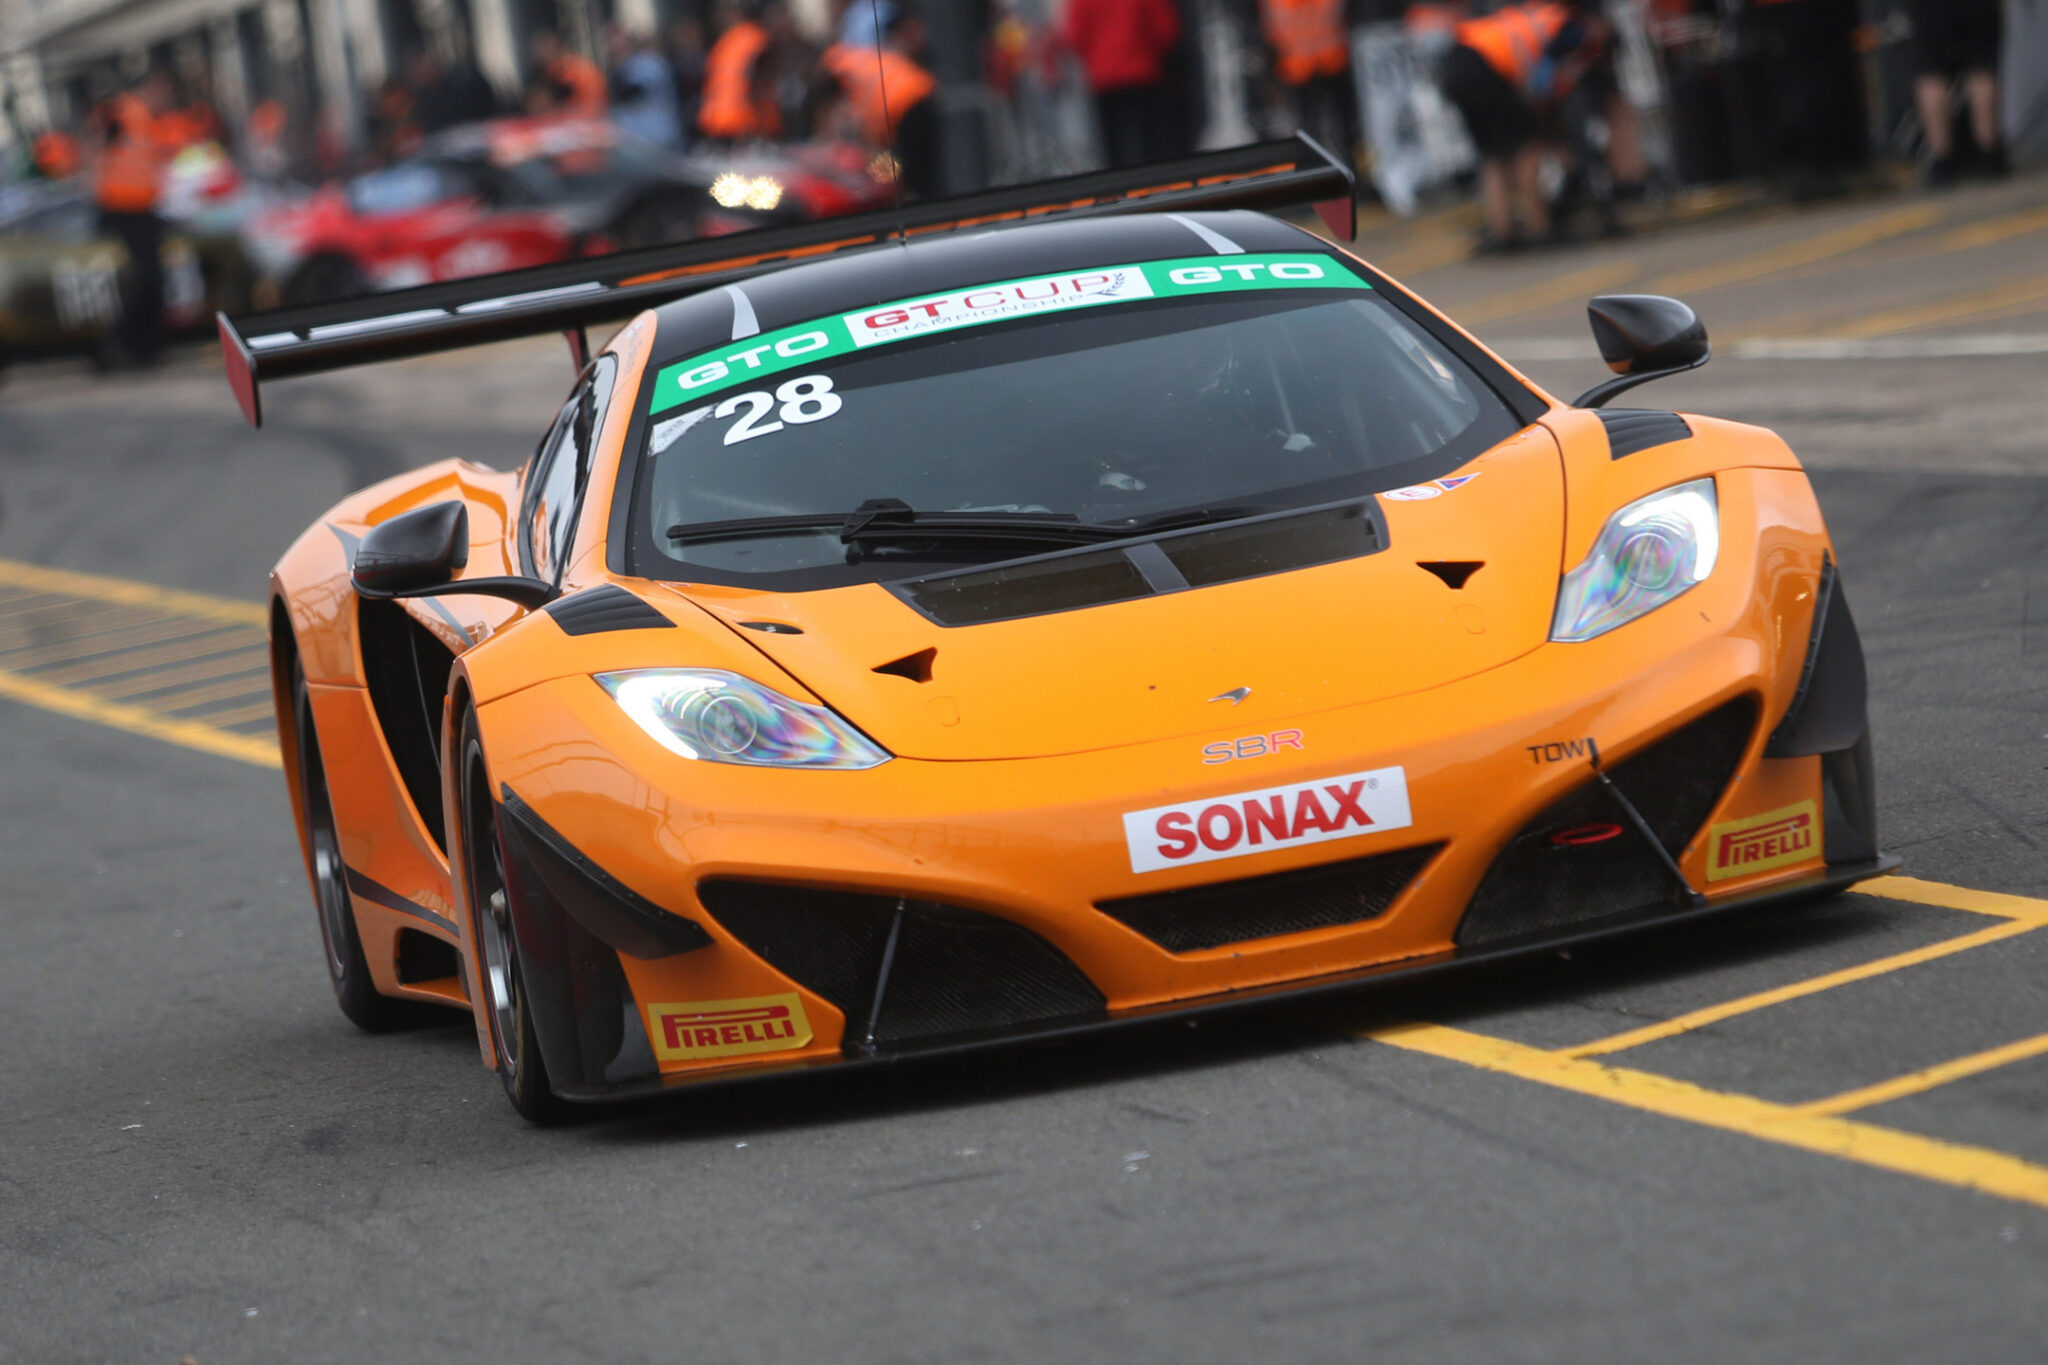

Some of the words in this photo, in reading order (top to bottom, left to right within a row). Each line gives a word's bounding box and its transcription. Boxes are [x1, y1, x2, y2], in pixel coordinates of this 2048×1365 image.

[1168, 262, 1326, 286] GTO
[864, 300, 948, 329] GT
[964, 275, 1109, 309] CUP
[874, 294, 1084, 338] CHAMPIONSHIP
[677, 330, 830, 390] GTO
[714, 374, 843, 446] 28
[1202, 728, 1305, 765] SBR
[1526, 738, 1586, 764] TOW
[1155, 779, 1376, 860] SONAX
[1716, 812, 1811, 869] PIRELLI
[660, 1005, 796, 1050] PIRELLI
